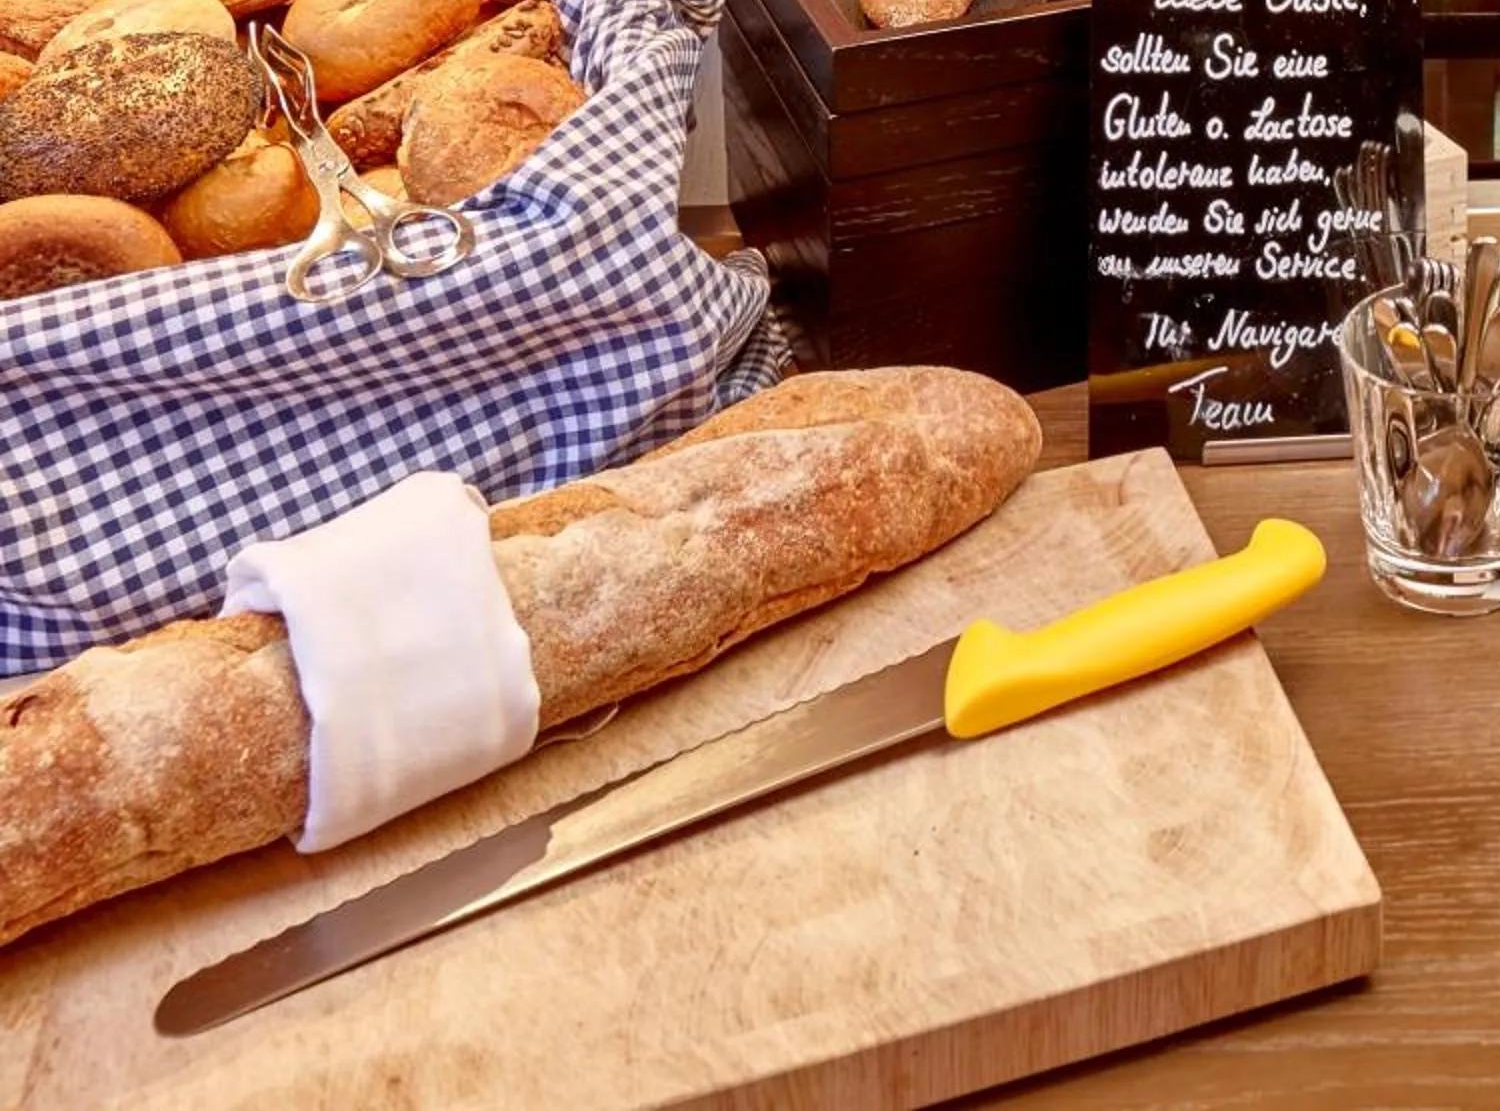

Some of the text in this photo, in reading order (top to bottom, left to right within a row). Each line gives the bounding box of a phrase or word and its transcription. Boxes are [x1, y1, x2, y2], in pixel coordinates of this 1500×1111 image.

[1100, 32, 1329, 80] sollten Sie eine
[1103, 90, 1353, 142] Gluten o. Lactose
[1098, 147, 1331, 190] intoleranz haben,
[1098, 198, 1383, 256] wenden Sie sich gerne
[1255, 238, 1367, 282] Service.
[1167, 366, 1275, 430] Team
